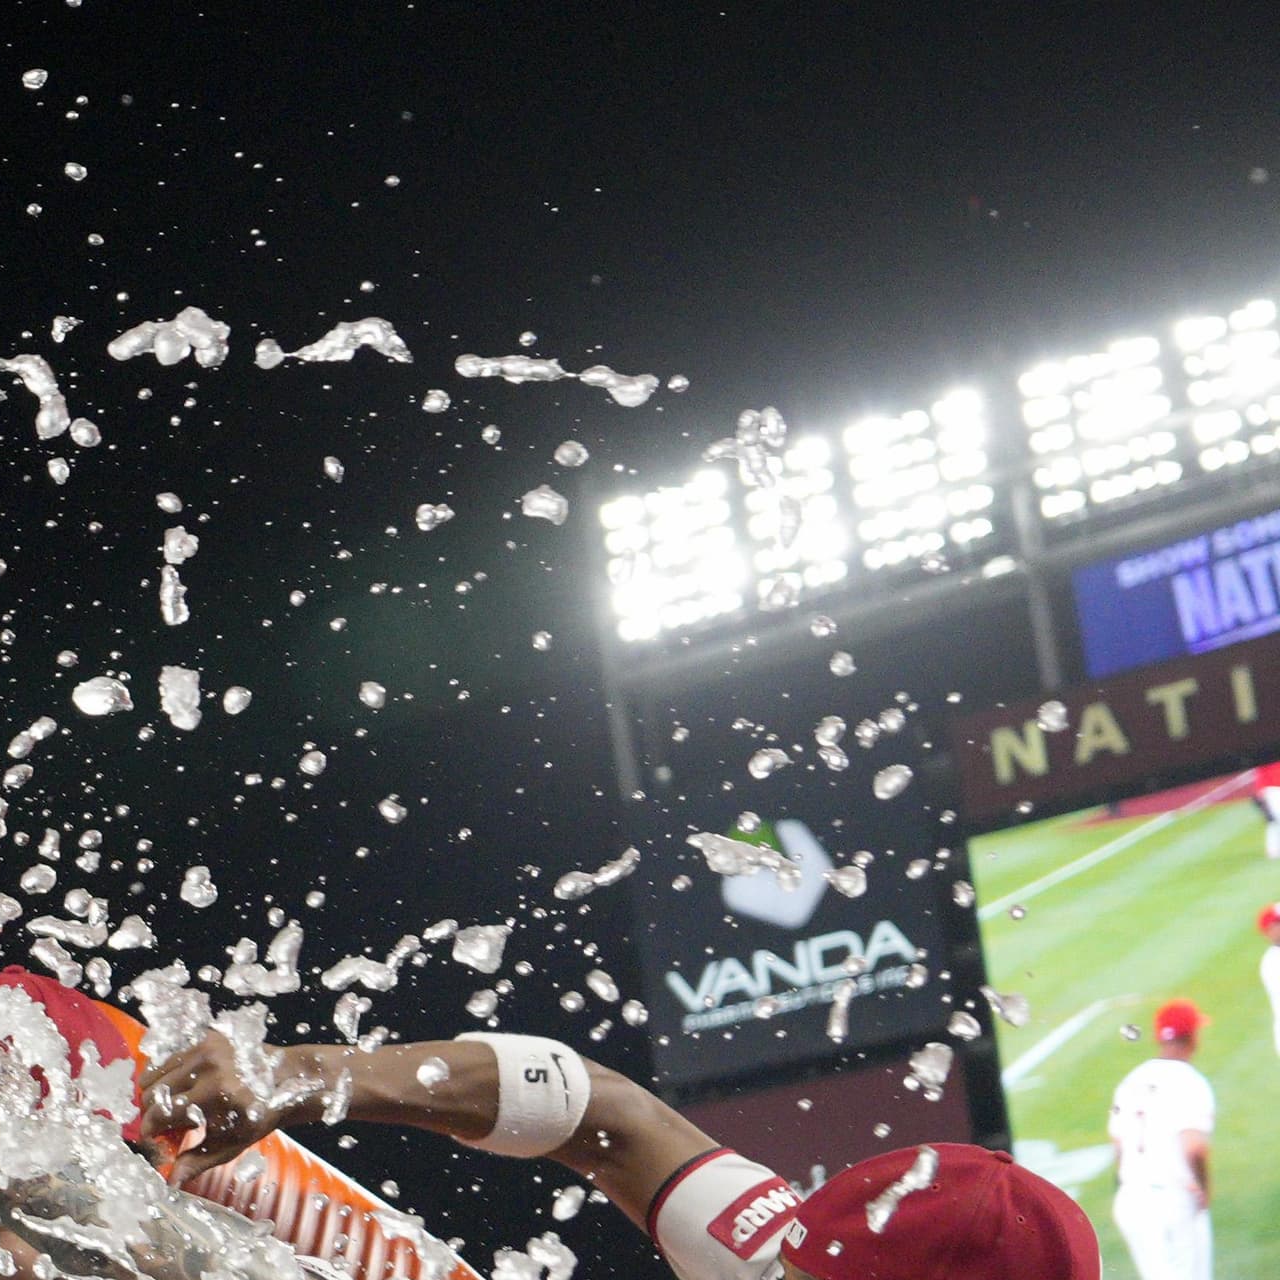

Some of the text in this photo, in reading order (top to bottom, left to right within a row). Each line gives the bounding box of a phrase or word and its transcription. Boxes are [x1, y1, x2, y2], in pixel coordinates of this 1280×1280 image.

[991, 665, 1258, 785] NATI
[666, 920, 918, 1013] VANDA
[525, 1068, 547, 1083] 5
